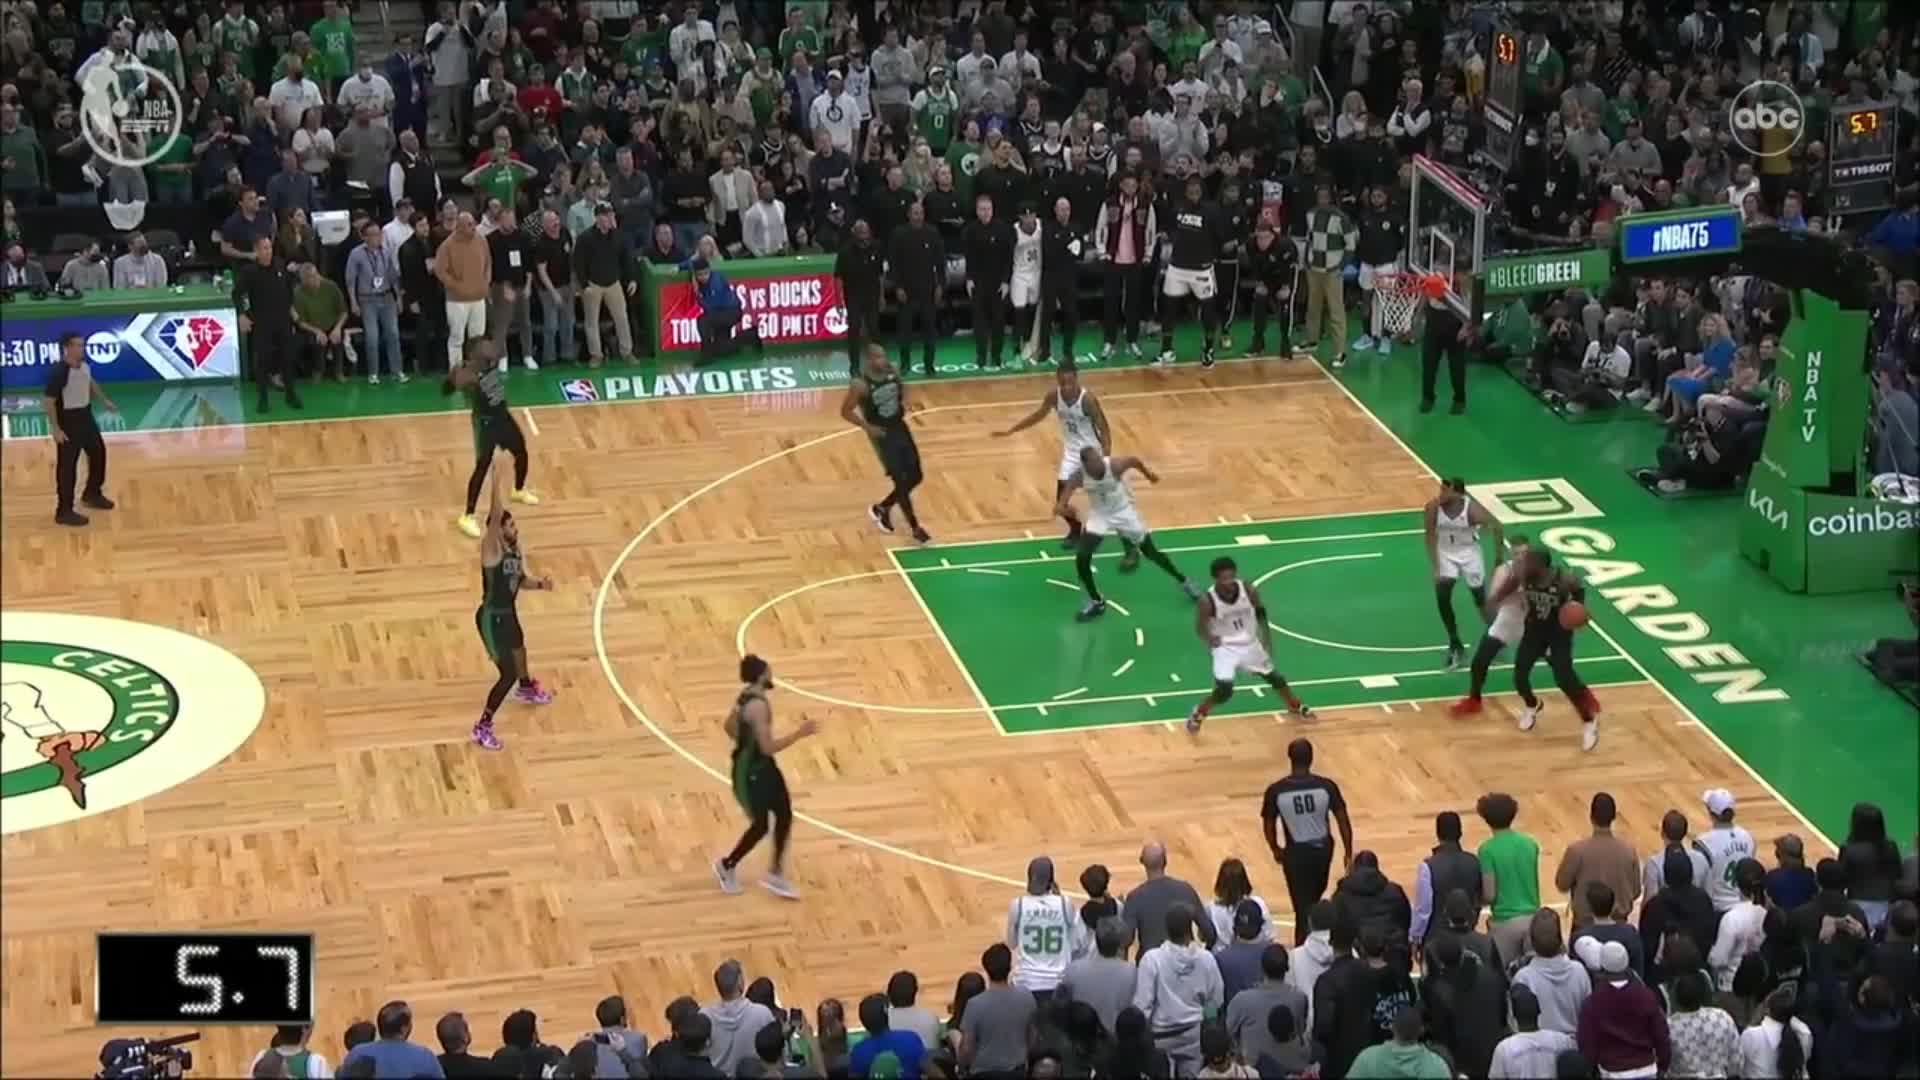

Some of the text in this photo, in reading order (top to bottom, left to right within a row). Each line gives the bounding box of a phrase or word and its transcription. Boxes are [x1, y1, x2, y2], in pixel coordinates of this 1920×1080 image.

[1850, 162, 1893, 176] TISSOT
[1652, 221, 1711, 253] #NBA75
[1490, 260, 1582, 289] #BLEEDGREEN
[769, 279, 822, 308] BUCKS
[782, 316, 803, 336] PM
[804, 314, 818, 335] ET
[40, 343, 61, 365] PM
[604, 366, 797, 400] PLAYOFFS
[1801, 351, 1822, 443] NBA TV
[1539, 525, 1791, 704] GARDEN
[51, 650, 170, 743] CELTICS
[1293, 794, 1316, 815] 60
[1023, 925, 1064, 954] 36
